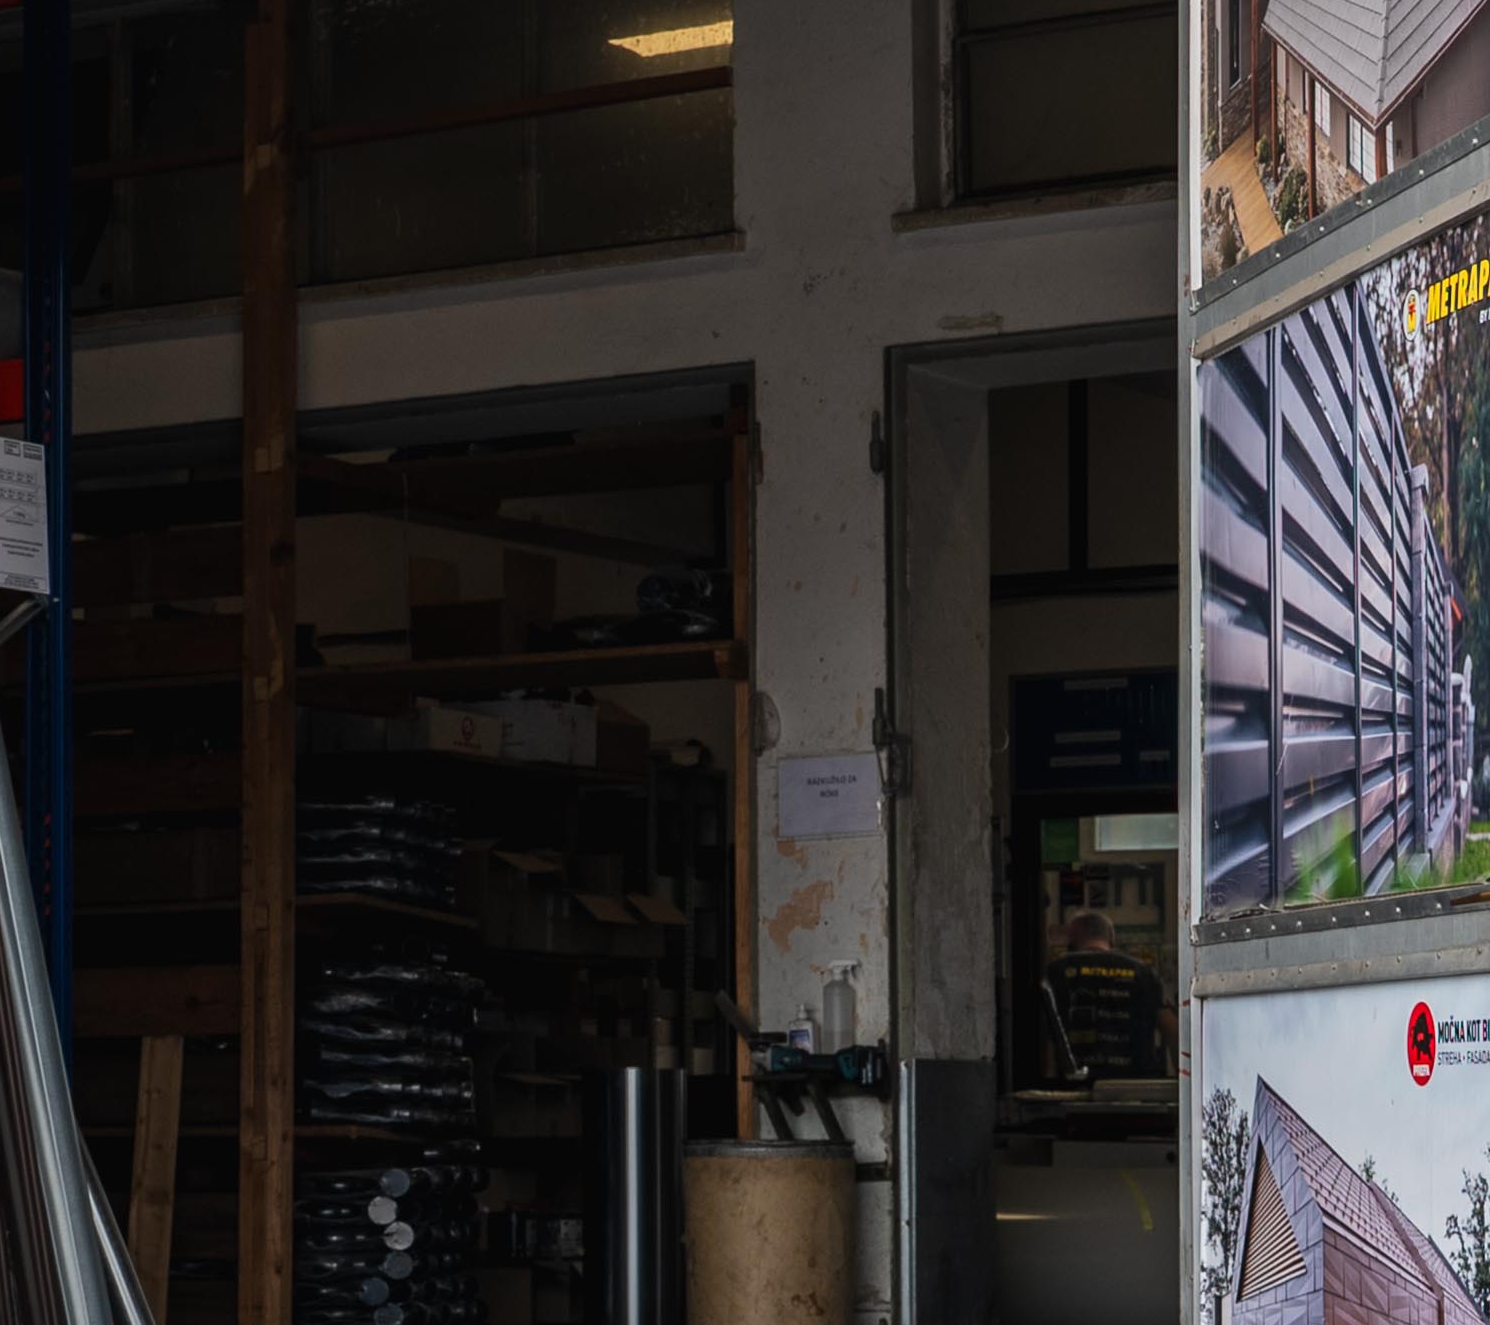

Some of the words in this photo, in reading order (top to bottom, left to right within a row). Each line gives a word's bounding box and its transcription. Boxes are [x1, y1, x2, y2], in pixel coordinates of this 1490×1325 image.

[1437, 1014, 1465, 1043] MOČNA
[1466, 1019, 1480, 1041] KOT
[1437, 1051, 1461, 1065] STREHA
[1466, 1050, 1490, 1063] FASADA
